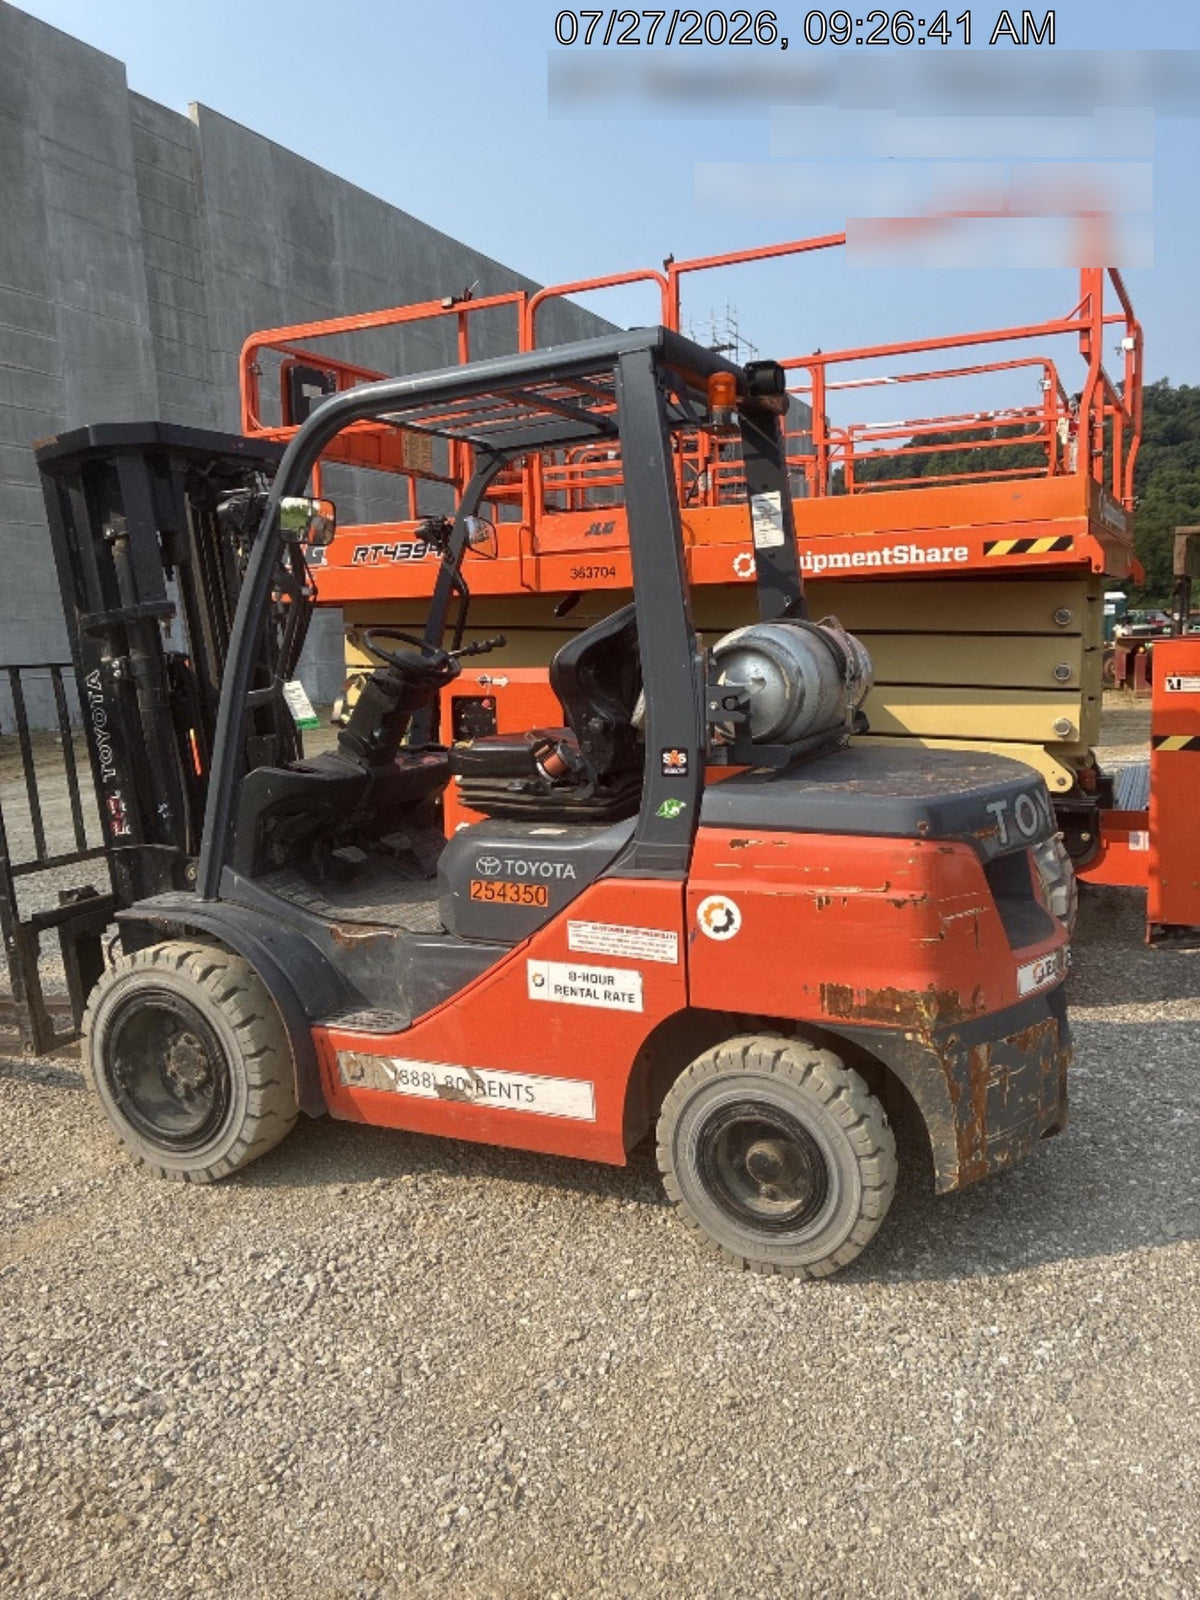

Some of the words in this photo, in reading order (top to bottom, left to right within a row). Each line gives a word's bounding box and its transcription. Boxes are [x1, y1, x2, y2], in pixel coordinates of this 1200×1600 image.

[800, 544, 968, 573] uipmentShare
[86, 669, 116, 783] TOYOTA
[505, 860, 576, 879] TOYOTA
[472, 881, 547, 905] 254350
[568, 971, 614, 986] 8-HOUR
[554, 984, 600, 1000] RENTAL
[604, 990, 636, 1003] RATE
